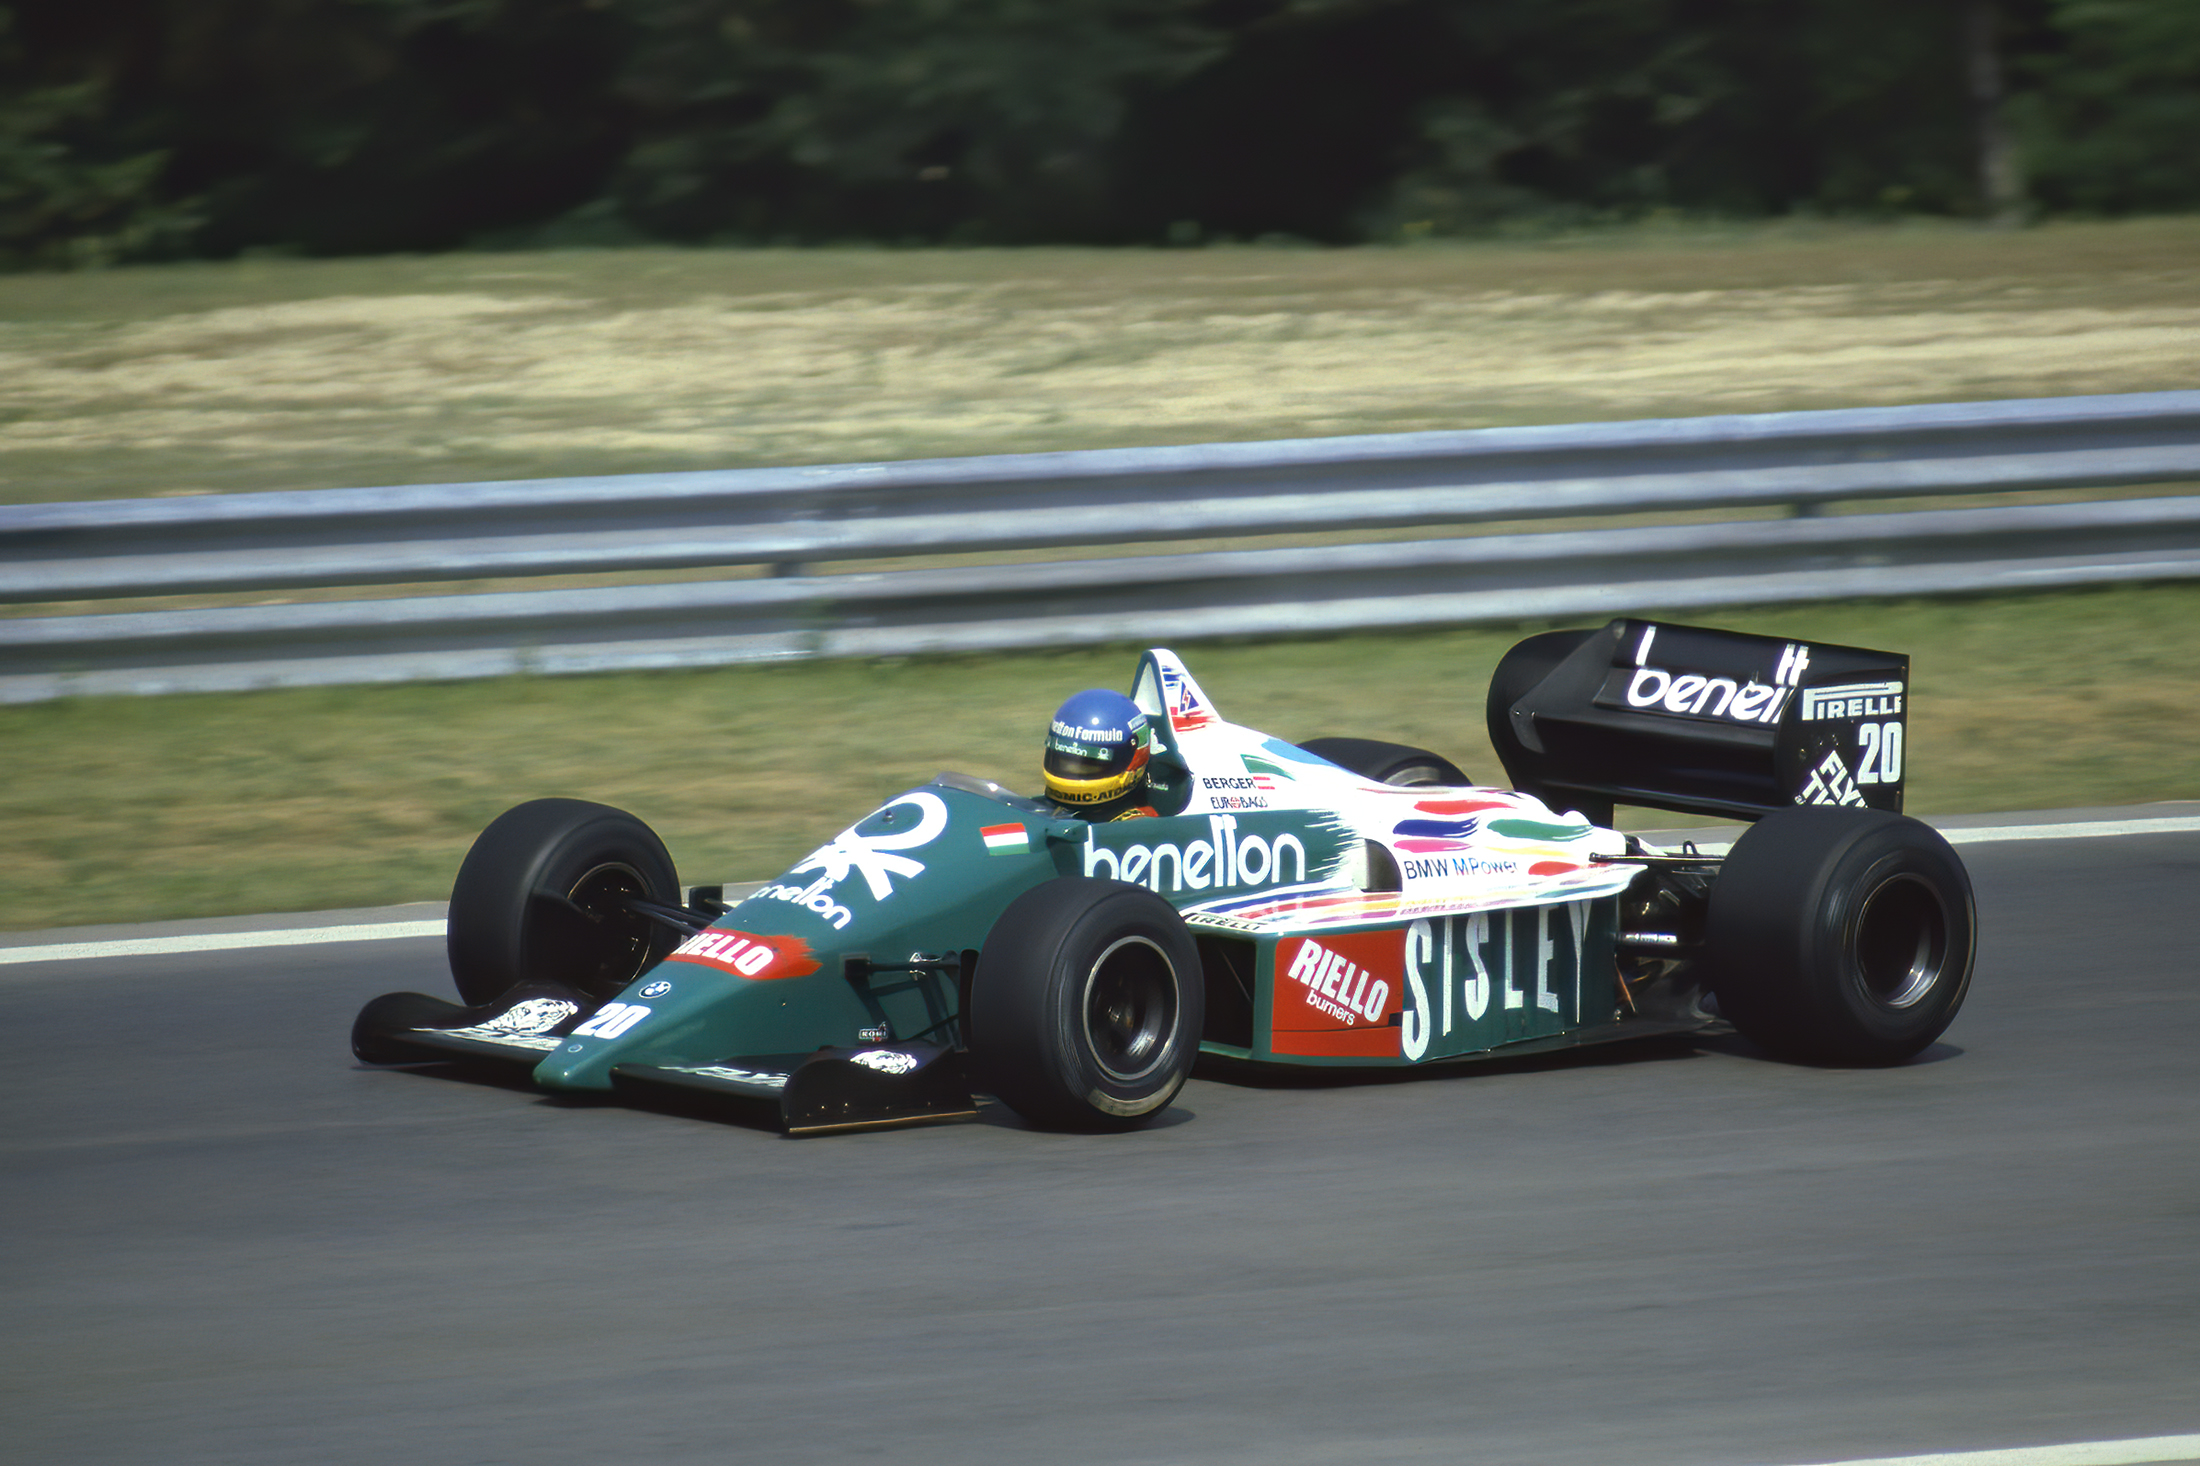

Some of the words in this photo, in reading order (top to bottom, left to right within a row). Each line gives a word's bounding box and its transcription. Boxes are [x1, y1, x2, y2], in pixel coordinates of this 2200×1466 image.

[1802, 681, 1904, 721] PIRELLI
[1075, 726, 1123, 742] Formula
[1857, 721, 1904, 785] 20
[1202, 777, 1256, 789] BERGER
[1084, 813, 1306, 892] benetton
[1403, 859, 1448, 879] BMW
[1287, 938, 1389, 1023] RIELLO
[1402, 898, 1593, 1062] SISLEY
[571, 1002, 652, 1039] 20
[1305, 989, 1355, 1026] burners
